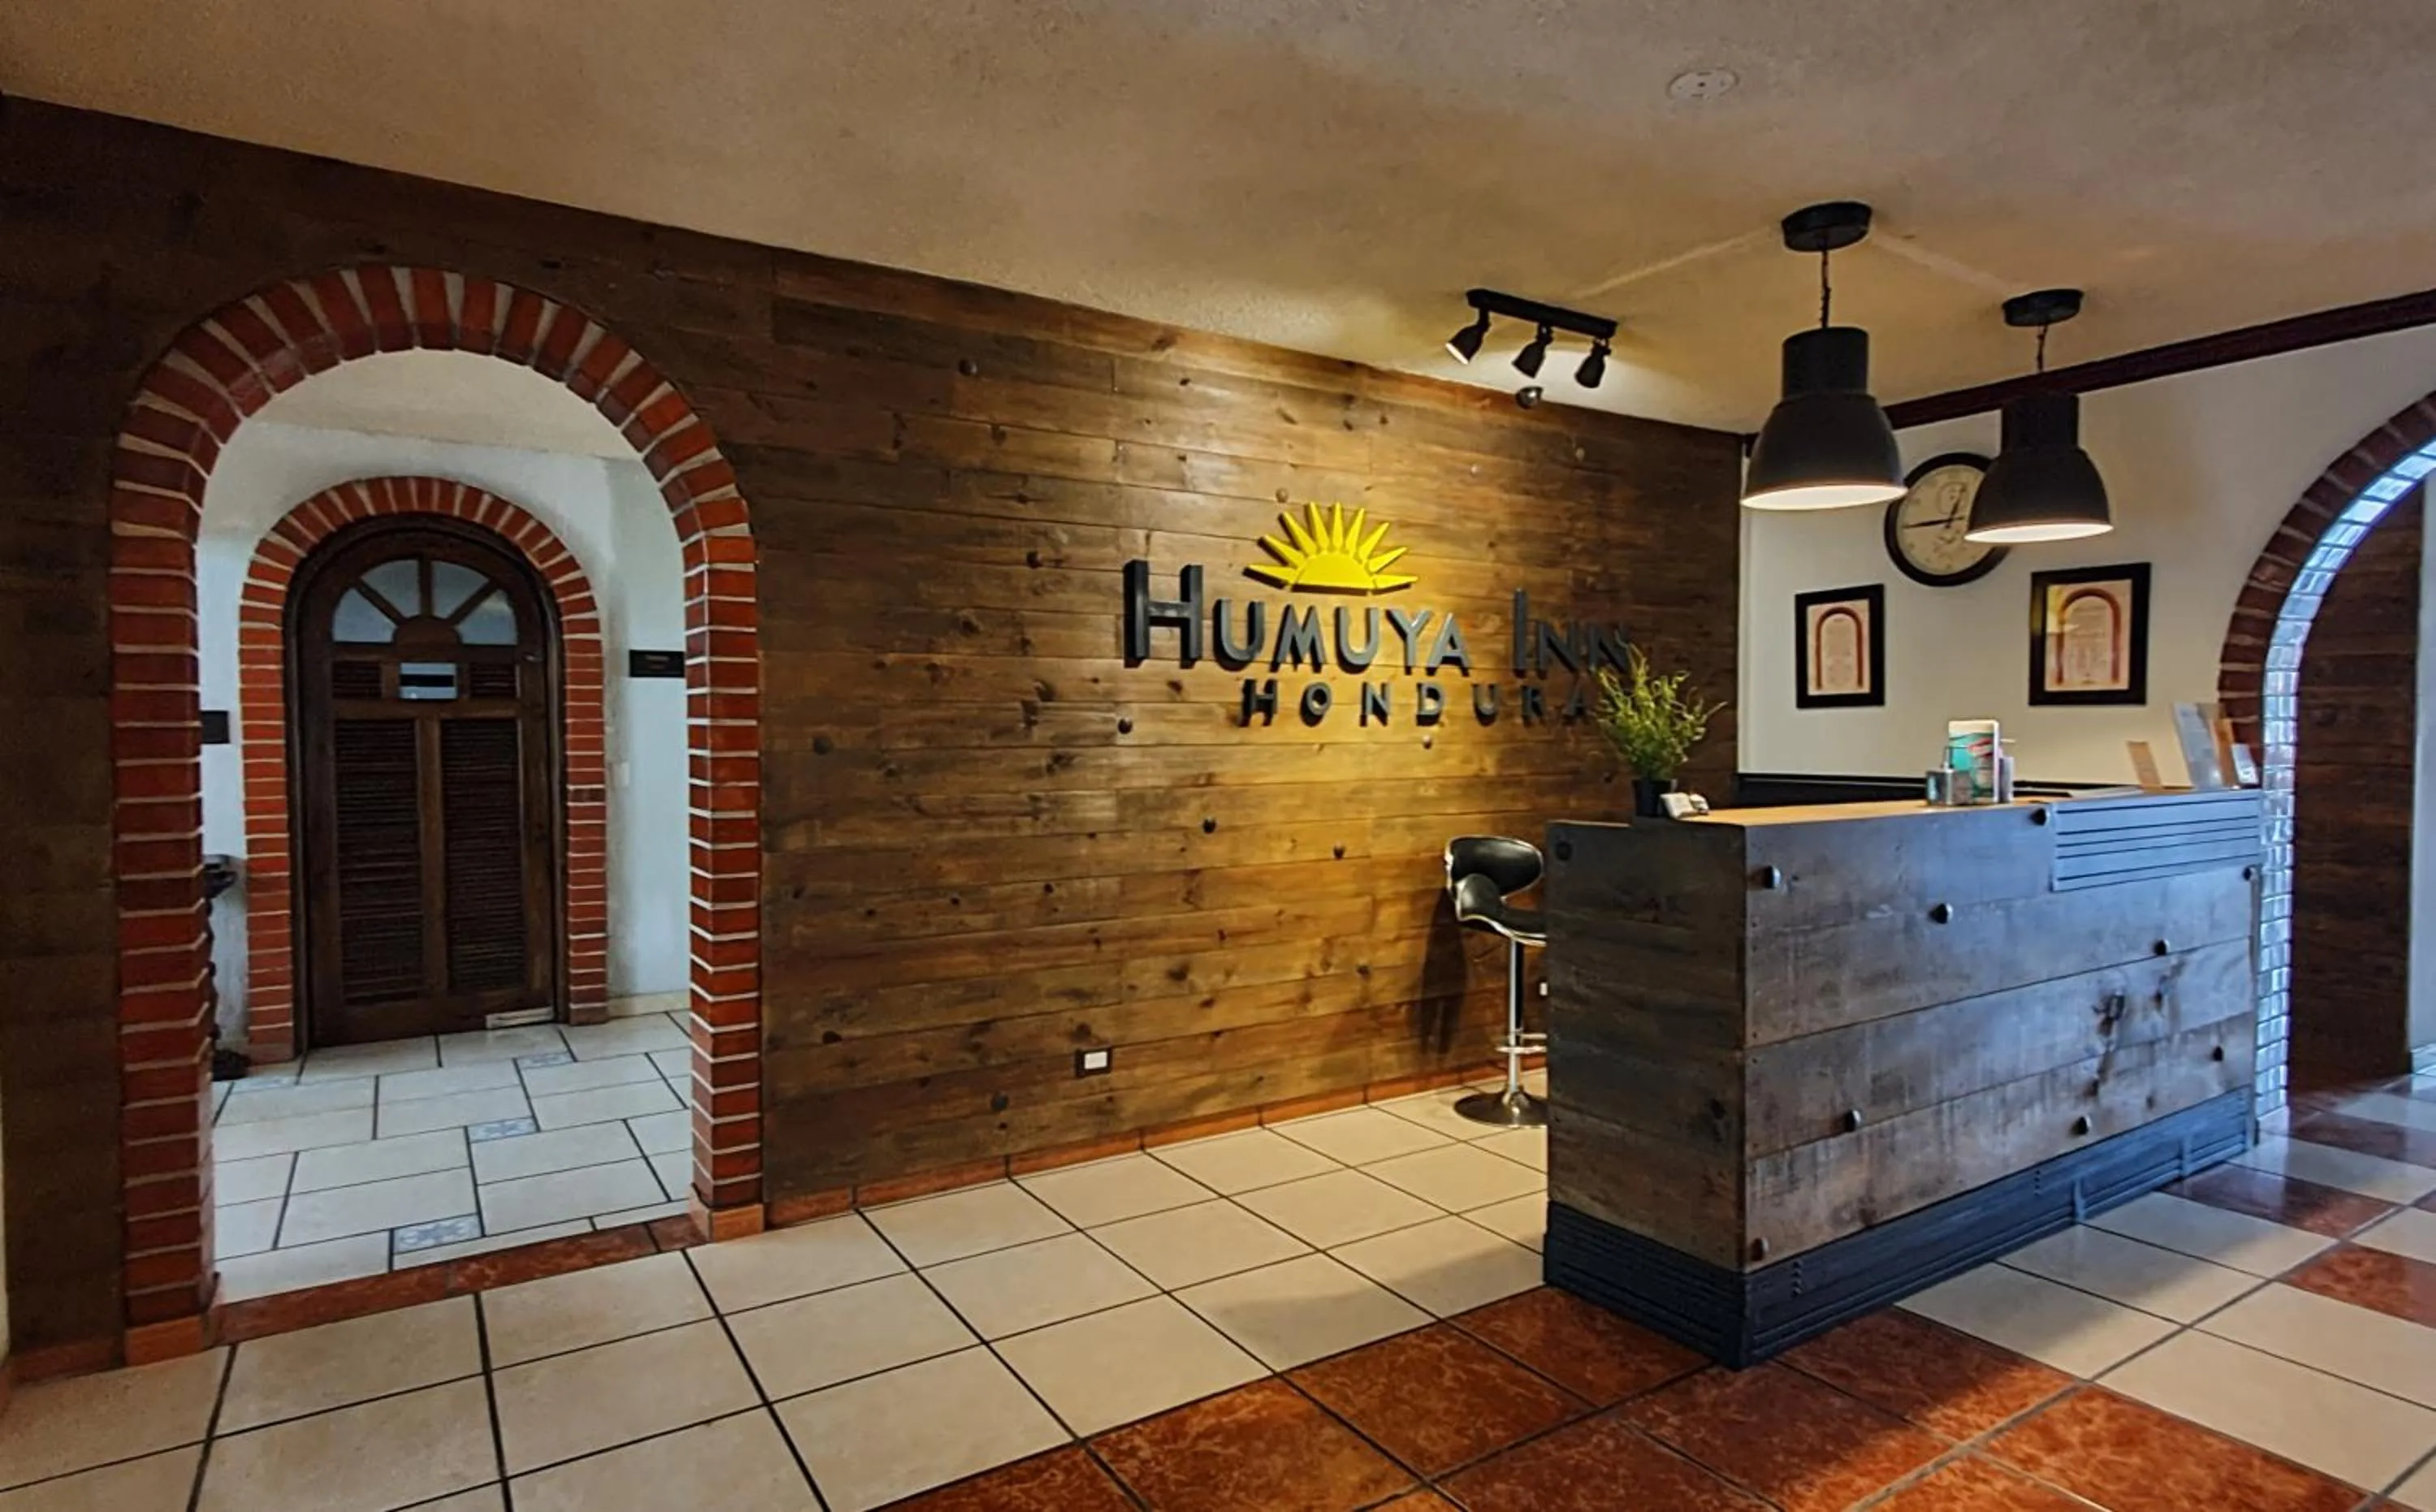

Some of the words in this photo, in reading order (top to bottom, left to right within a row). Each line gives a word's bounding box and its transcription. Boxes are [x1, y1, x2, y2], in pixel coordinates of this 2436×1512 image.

[1124, 559, 1471, 676] HUMUYA
[1514, 587, 1631, 679] INN
[1240, 677, 1596, 727] HONDURA
